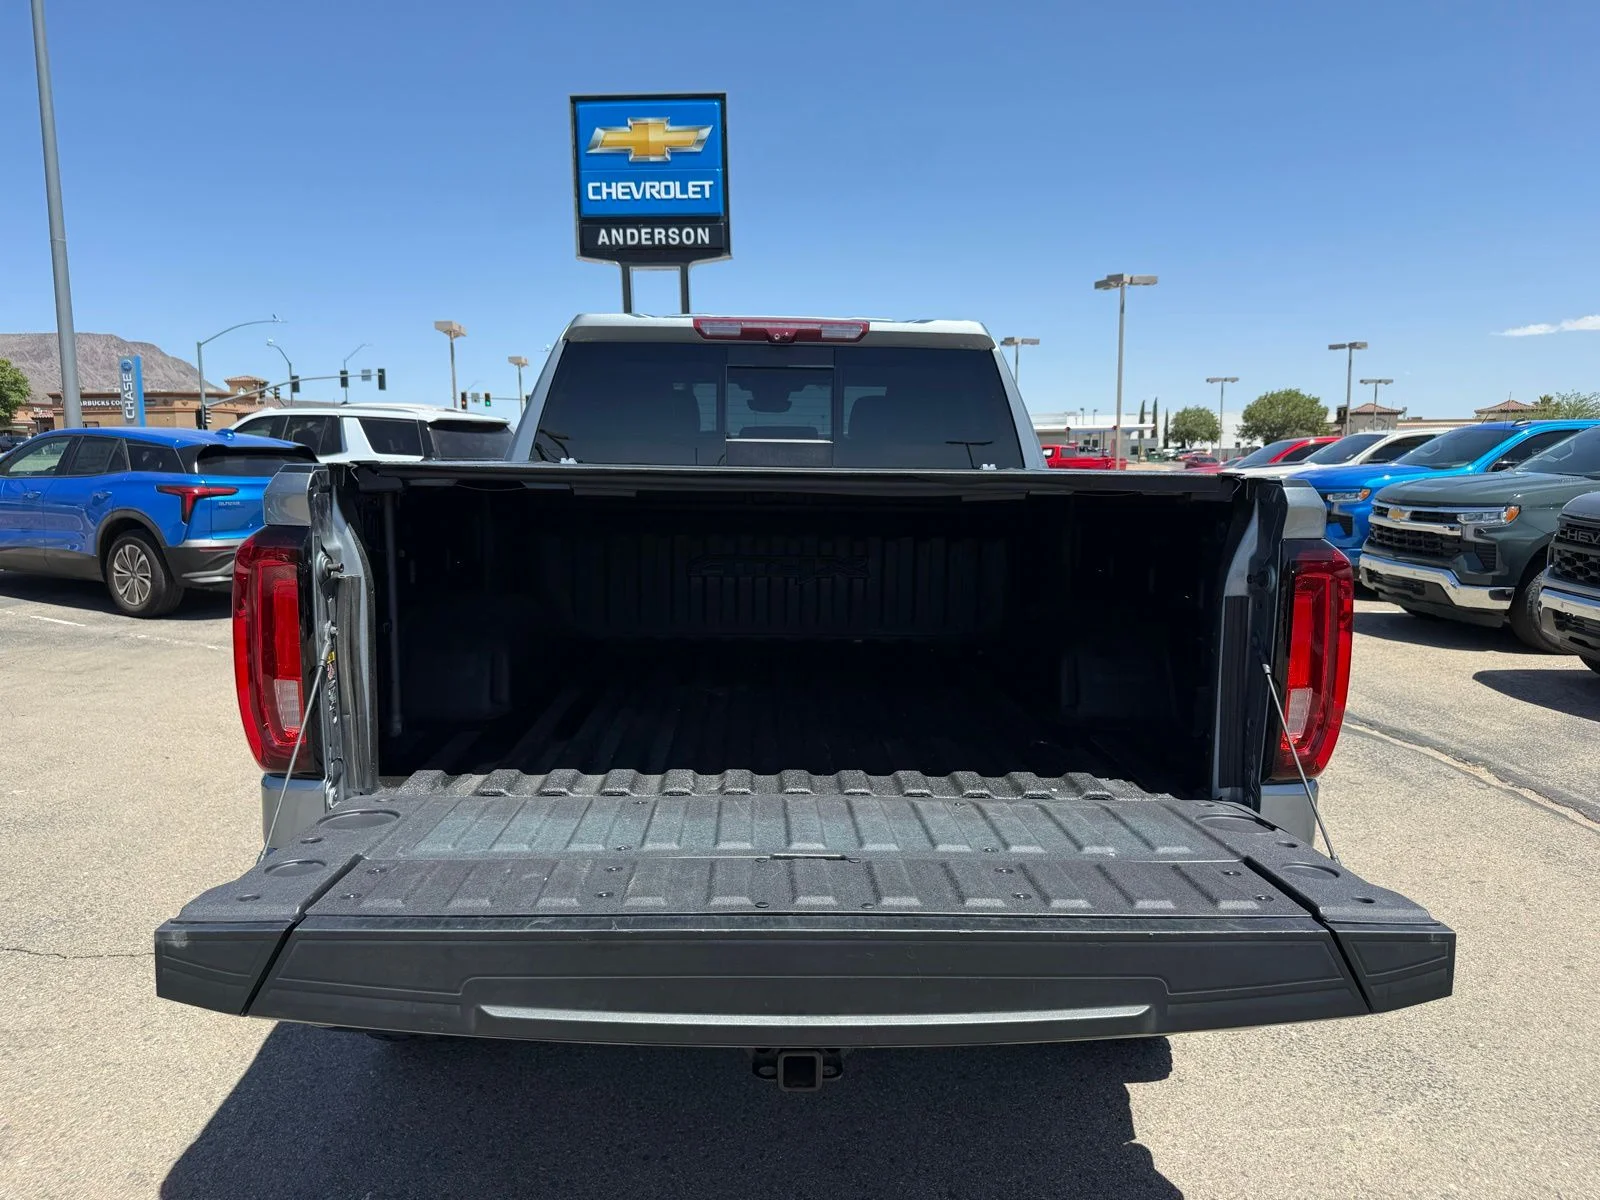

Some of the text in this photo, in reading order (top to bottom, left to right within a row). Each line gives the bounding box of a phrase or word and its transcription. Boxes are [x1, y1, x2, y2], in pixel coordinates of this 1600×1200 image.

[587, 181, 714, 200] CHEVROLET
[597, 227, 710, 245] ANDERSON
[122, 373, 135, 419] CHASE
